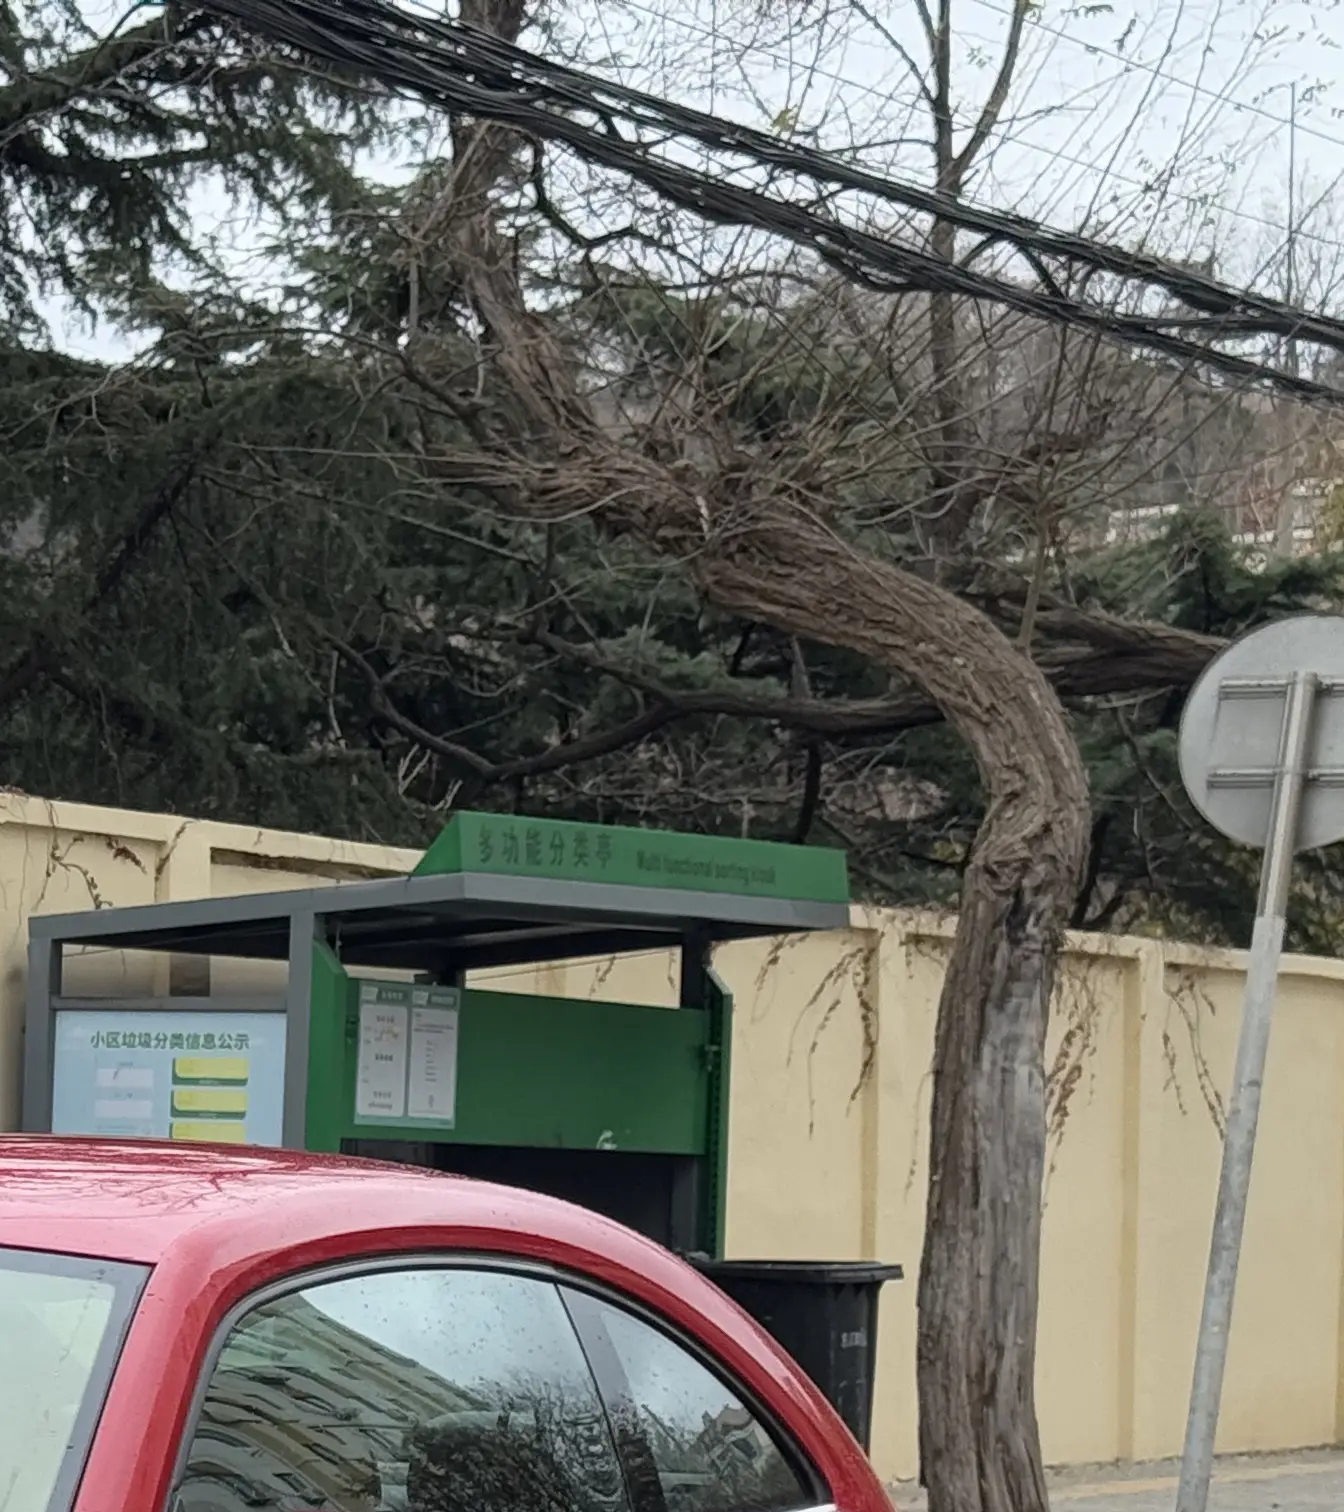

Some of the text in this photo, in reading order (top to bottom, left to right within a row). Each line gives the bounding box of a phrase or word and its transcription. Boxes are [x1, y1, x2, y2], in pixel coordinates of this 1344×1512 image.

[478, 824, 612, 870] 多功能分类亭
[90, 1031, 250, 1051] 小区垃圾分类信息公示
